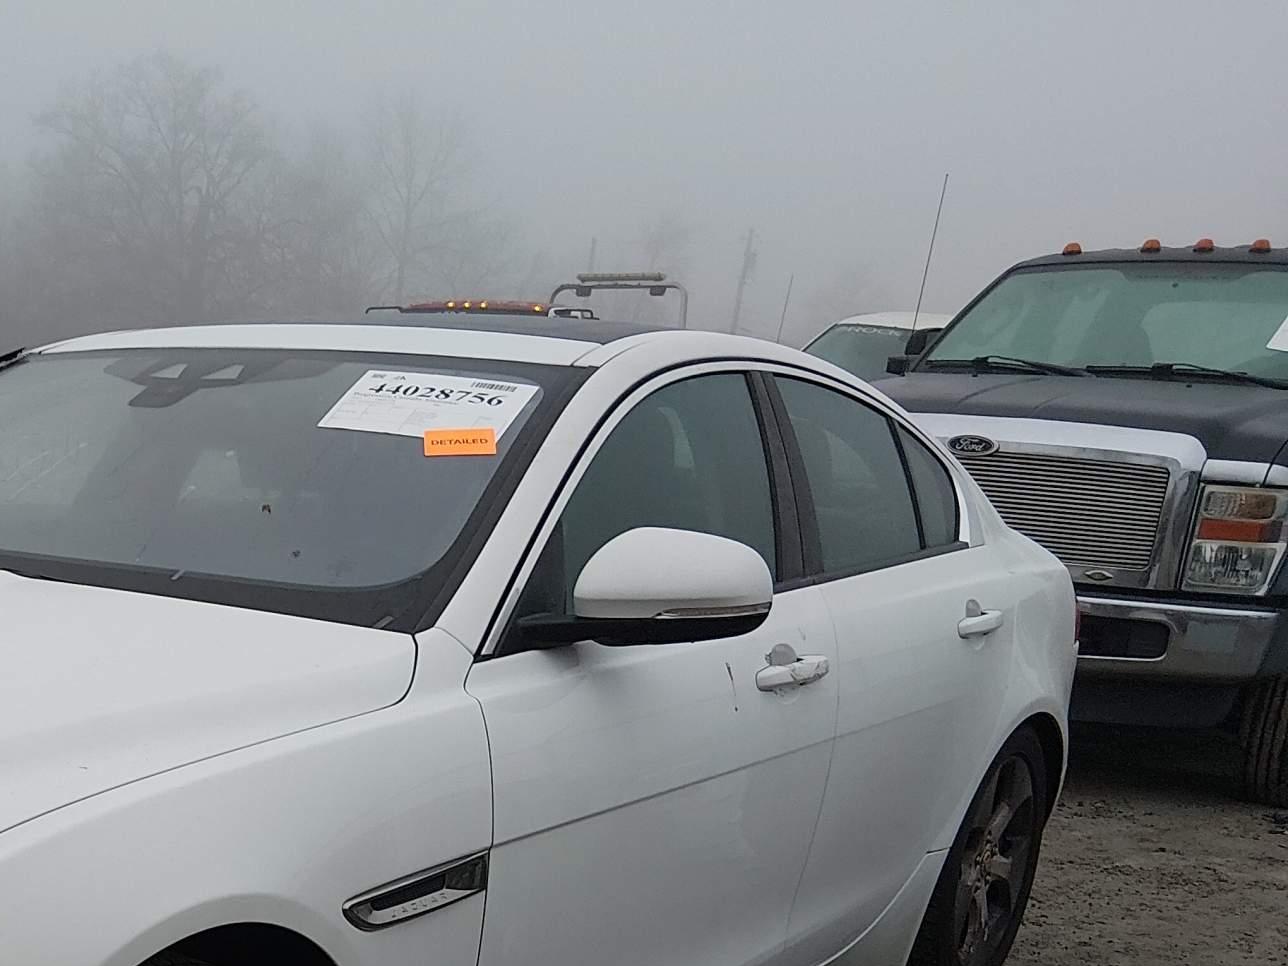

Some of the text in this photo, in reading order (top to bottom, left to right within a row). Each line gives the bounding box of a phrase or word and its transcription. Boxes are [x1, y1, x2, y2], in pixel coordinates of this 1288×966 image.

[368, 382, 510, 407] 44028756
[430, 437, 489, 447] DETAILED
[955, 437, 987, 452] Ford
